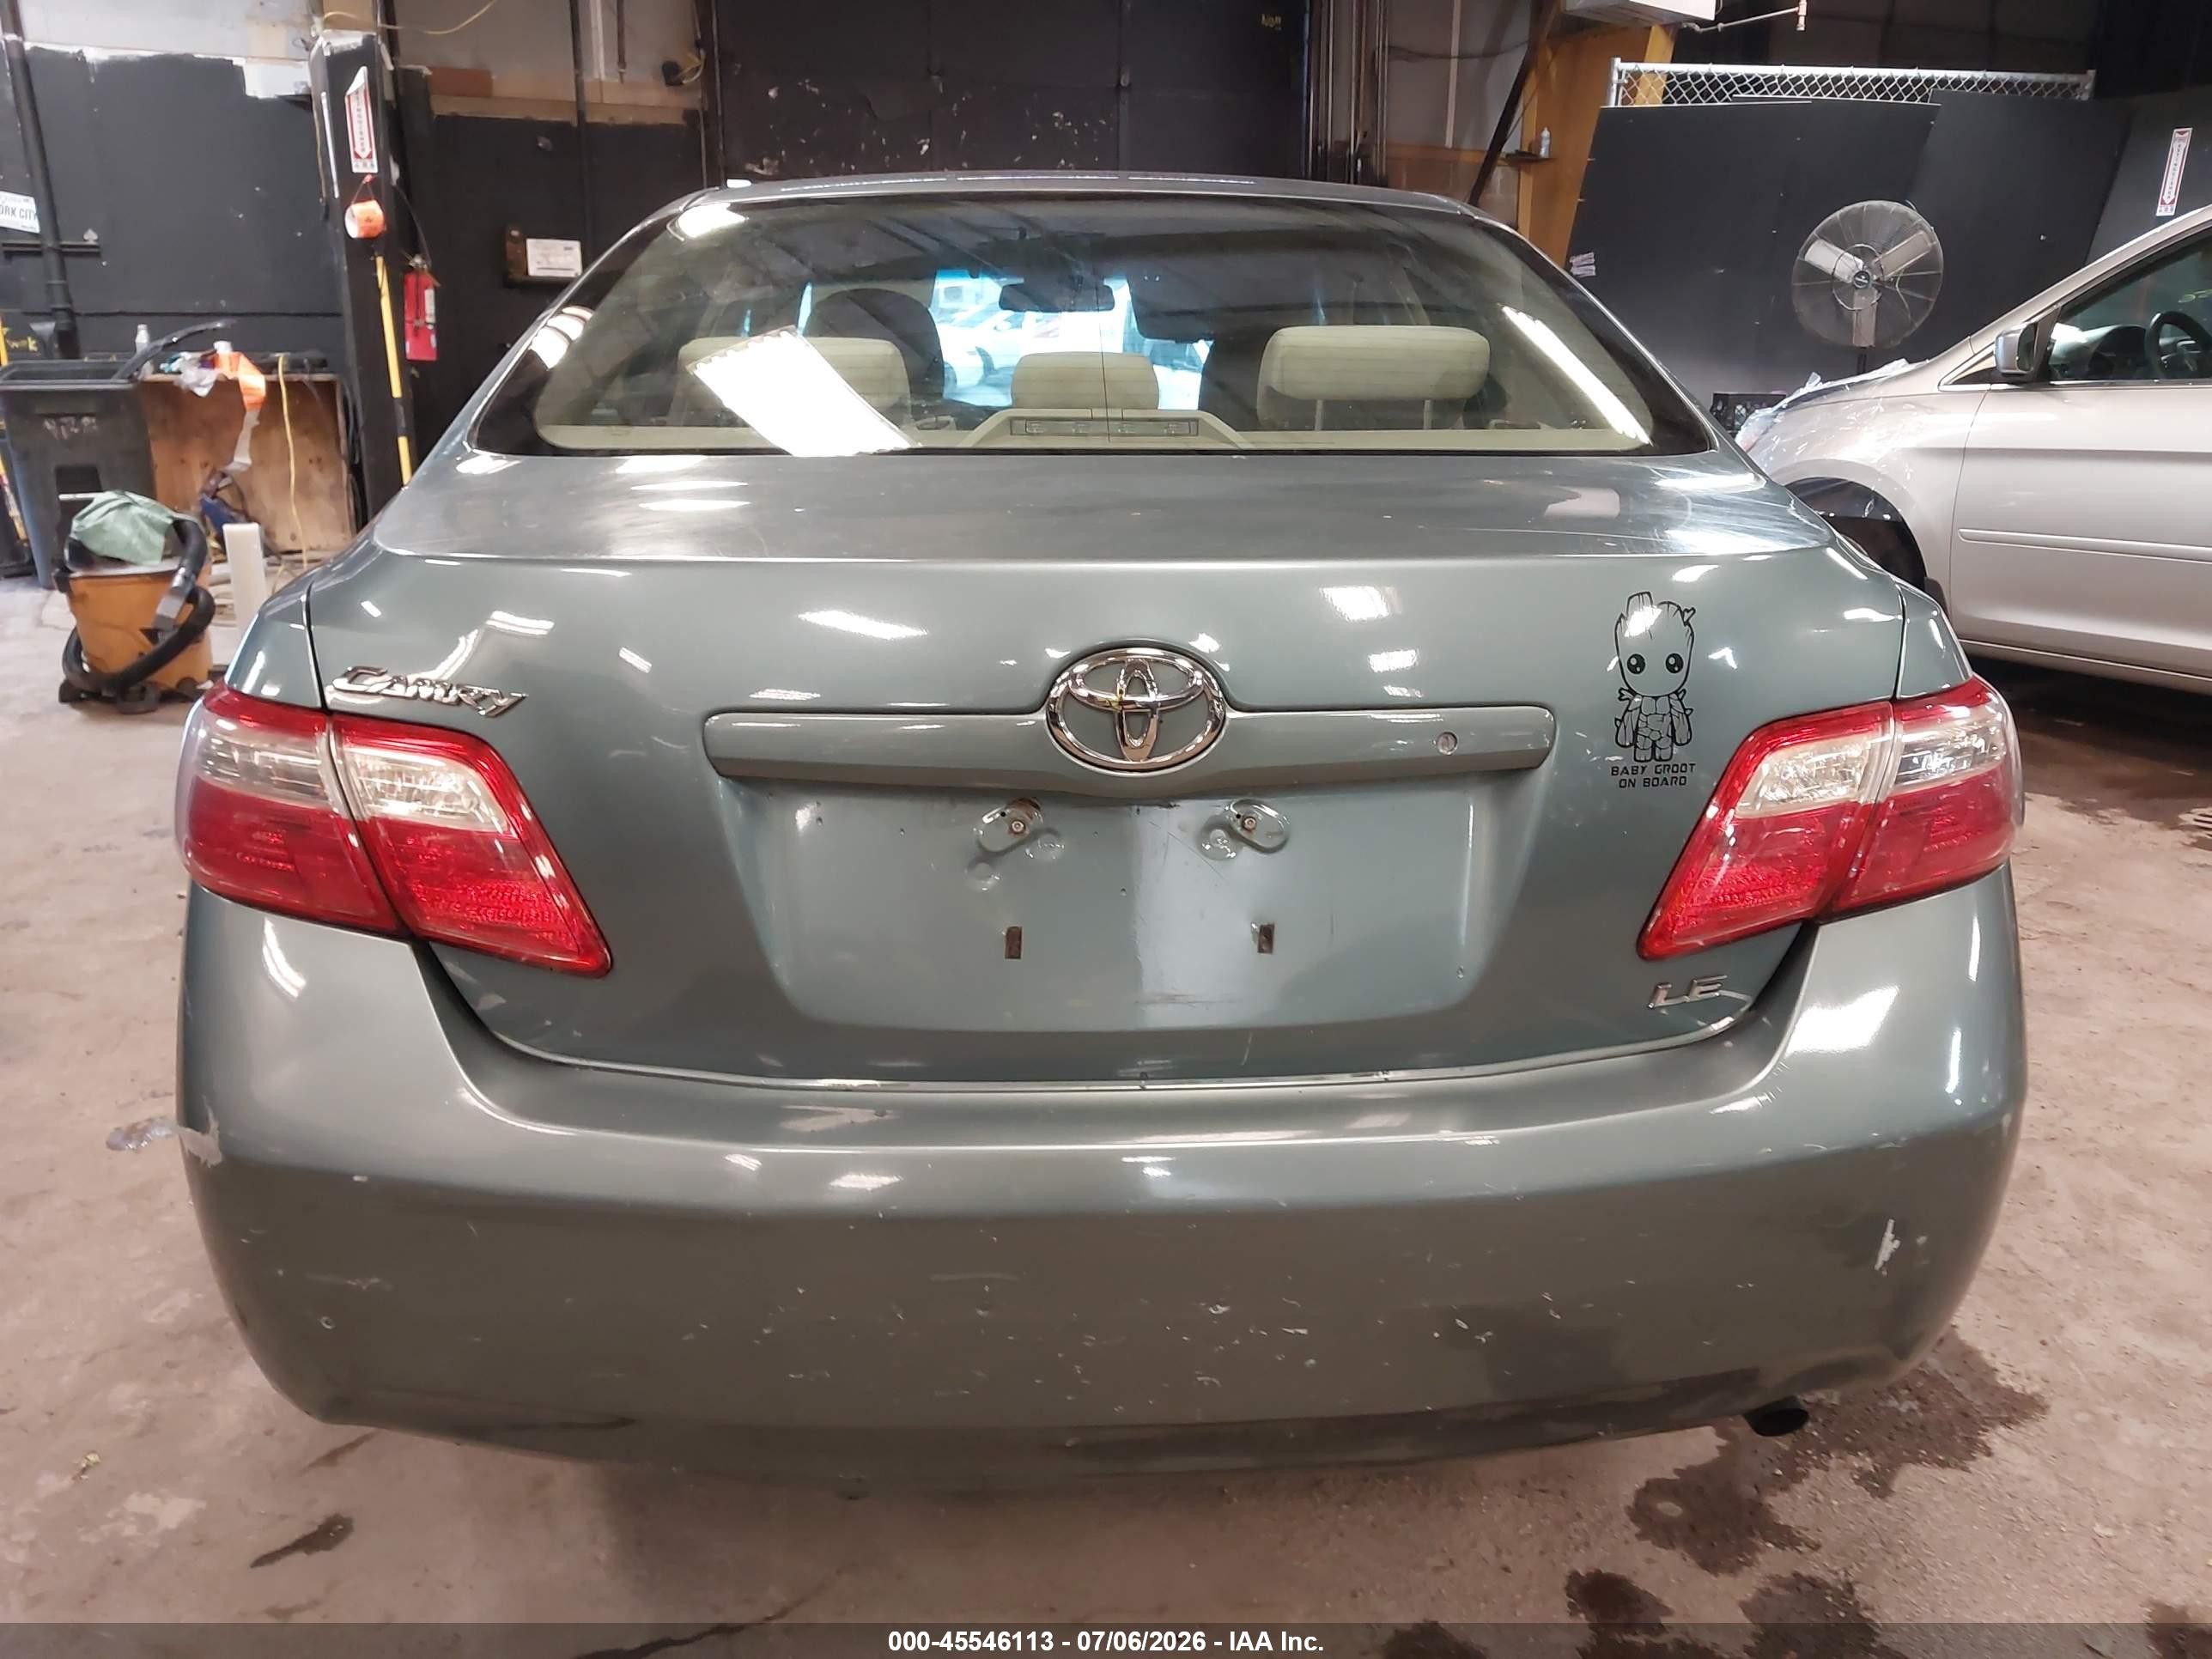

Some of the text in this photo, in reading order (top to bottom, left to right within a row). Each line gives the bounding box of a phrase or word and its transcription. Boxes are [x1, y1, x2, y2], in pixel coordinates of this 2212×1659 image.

[1611, 763, 1696, 776] BABY GROOT
[1619, 775, 1687, 788] ON BOARD
[1648, 975, 1728, 1009] LE
